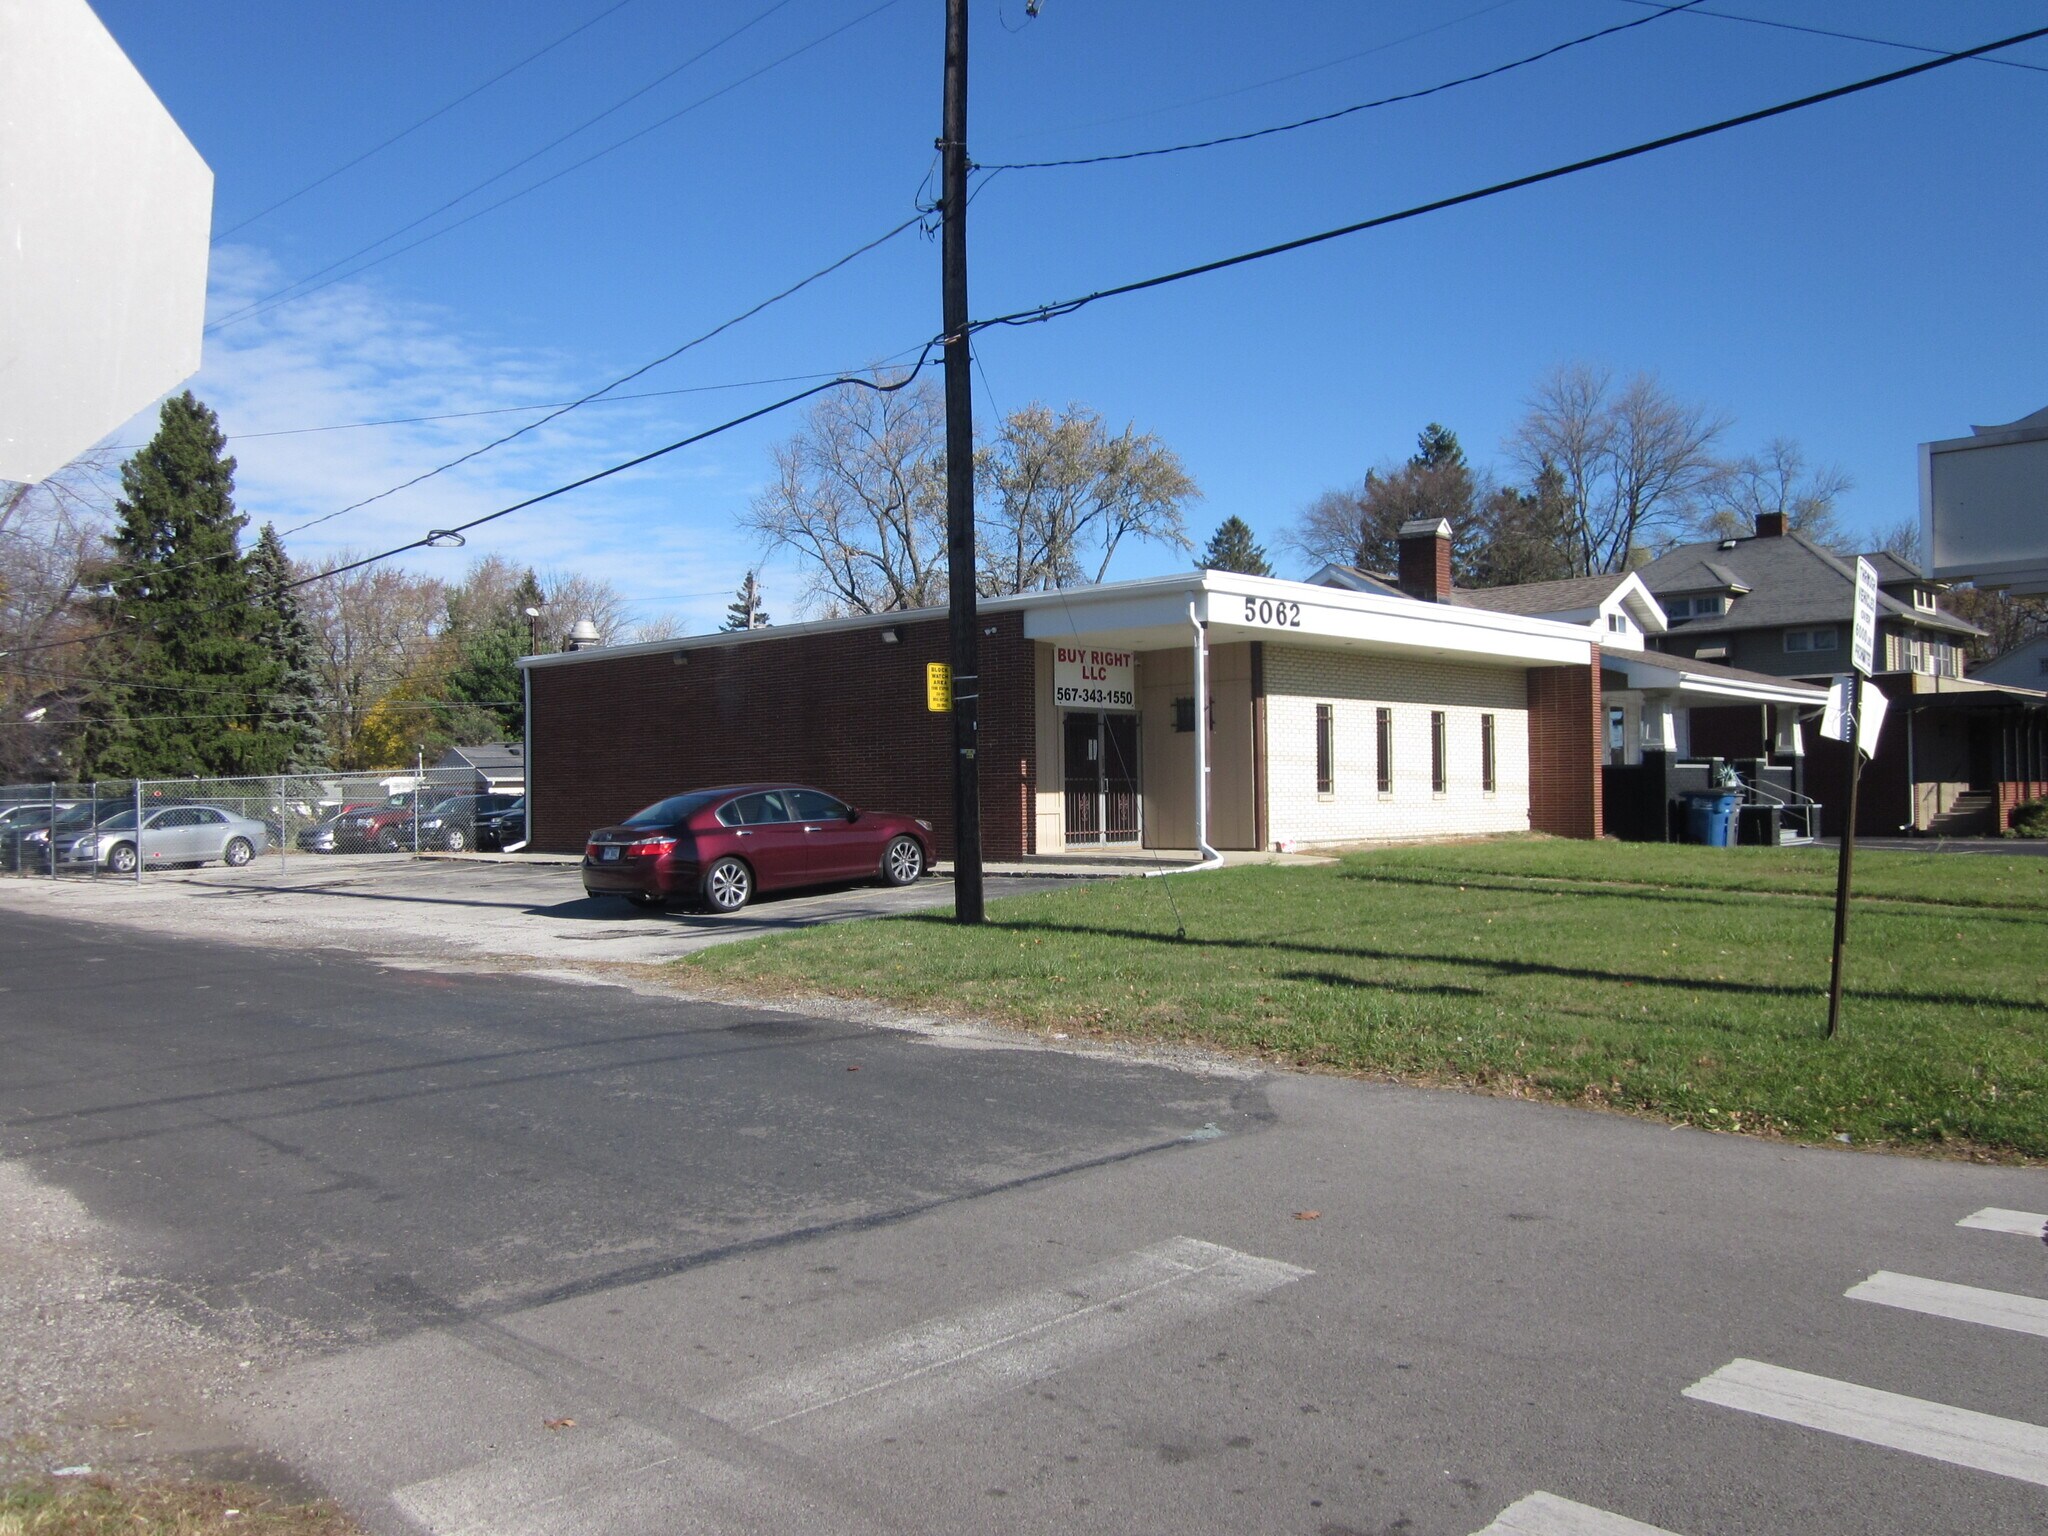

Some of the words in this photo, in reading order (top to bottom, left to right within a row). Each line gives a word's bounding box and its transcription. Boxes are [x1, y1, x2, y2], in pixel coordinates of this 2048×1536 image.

[1858, 586, 1875, 612] VEHICLES
[1245, 596, 1300, 627] 5062
[1860, 610, 1871, 625] OVER
[1856, 623, 1868, 645] 6000
[1057, 648, 1086, 664] BUY
[1091, 651, 1131, 668] RIGHT
[1082, 665, 1107, 681] LLC
[1057, 687, 1133, 704] 567-343-1550
